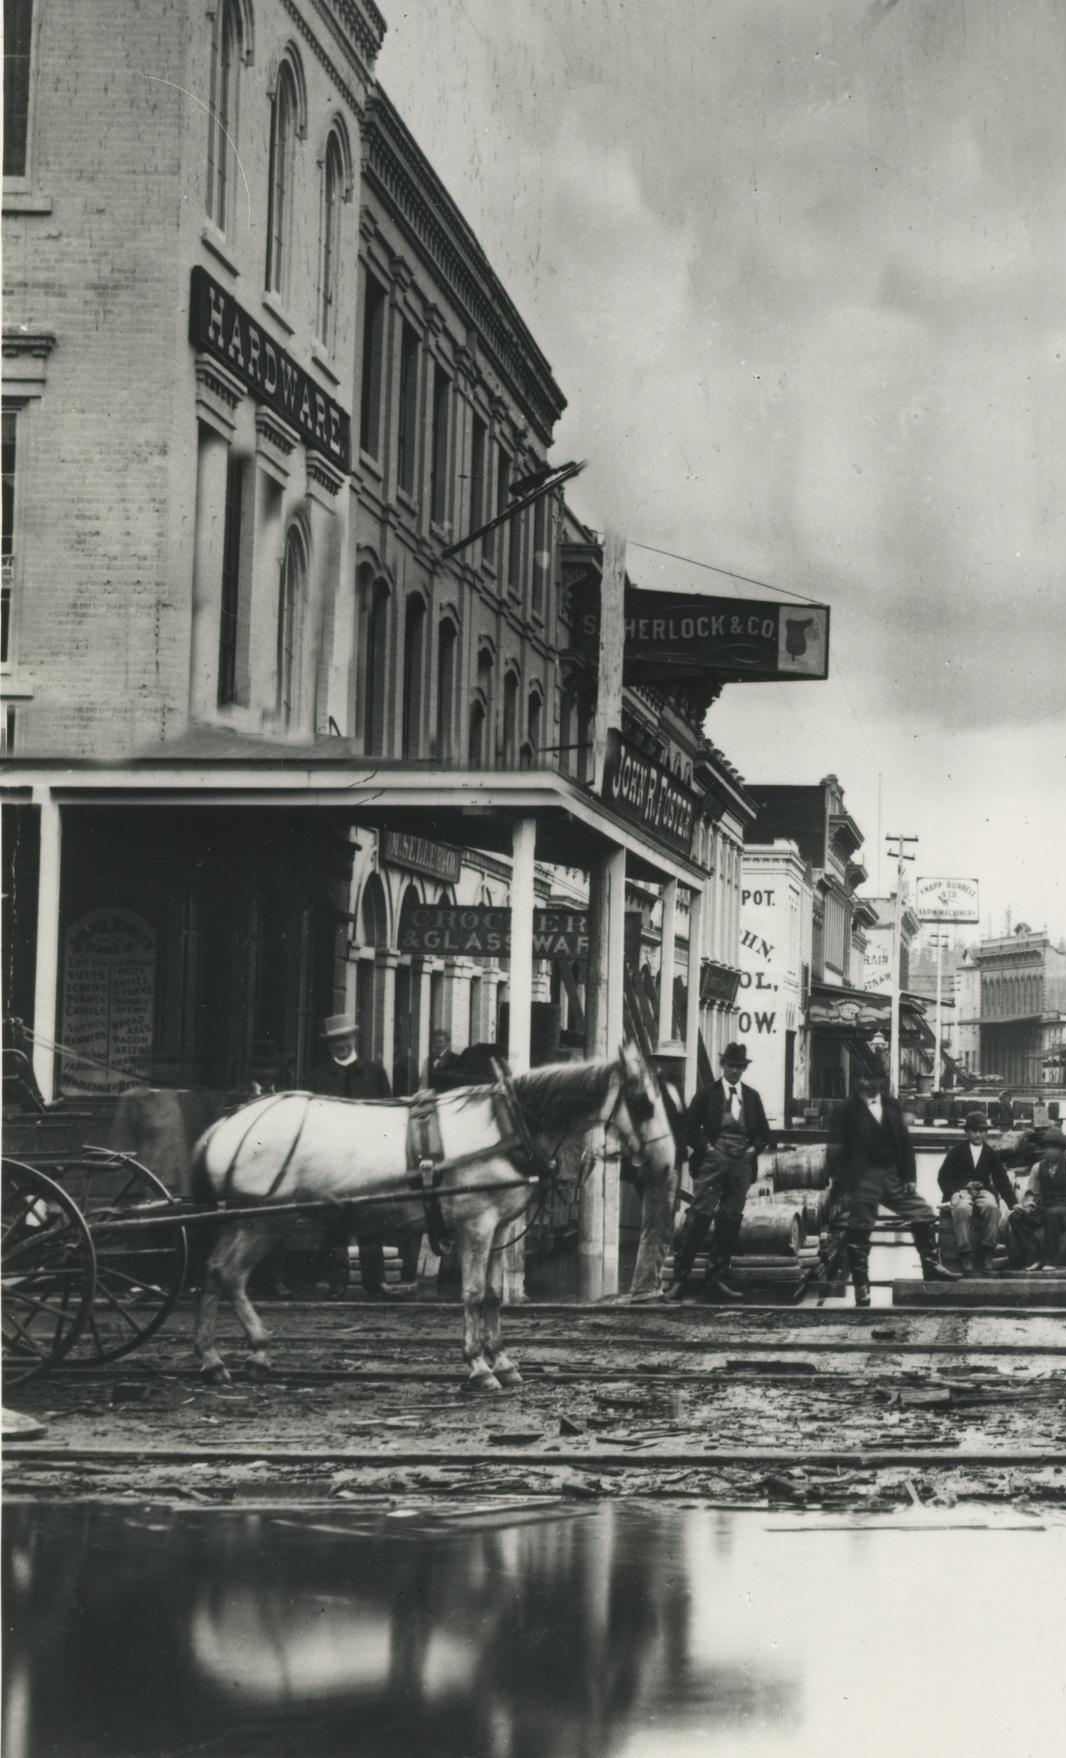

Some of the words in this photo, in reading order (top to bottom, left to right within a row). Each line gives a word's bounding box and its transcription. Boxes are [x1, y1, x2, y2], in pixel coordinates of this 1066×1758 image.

[622, 616, 725, 641] HERLOCK
[731, 615, 743, 635] &
[613, 744, 648, 808] JOHN
[655, 776, 692, 840] FOSTER
[411, 909, 590, 934] CROCER
[740, 929, 776, 963] HN,
